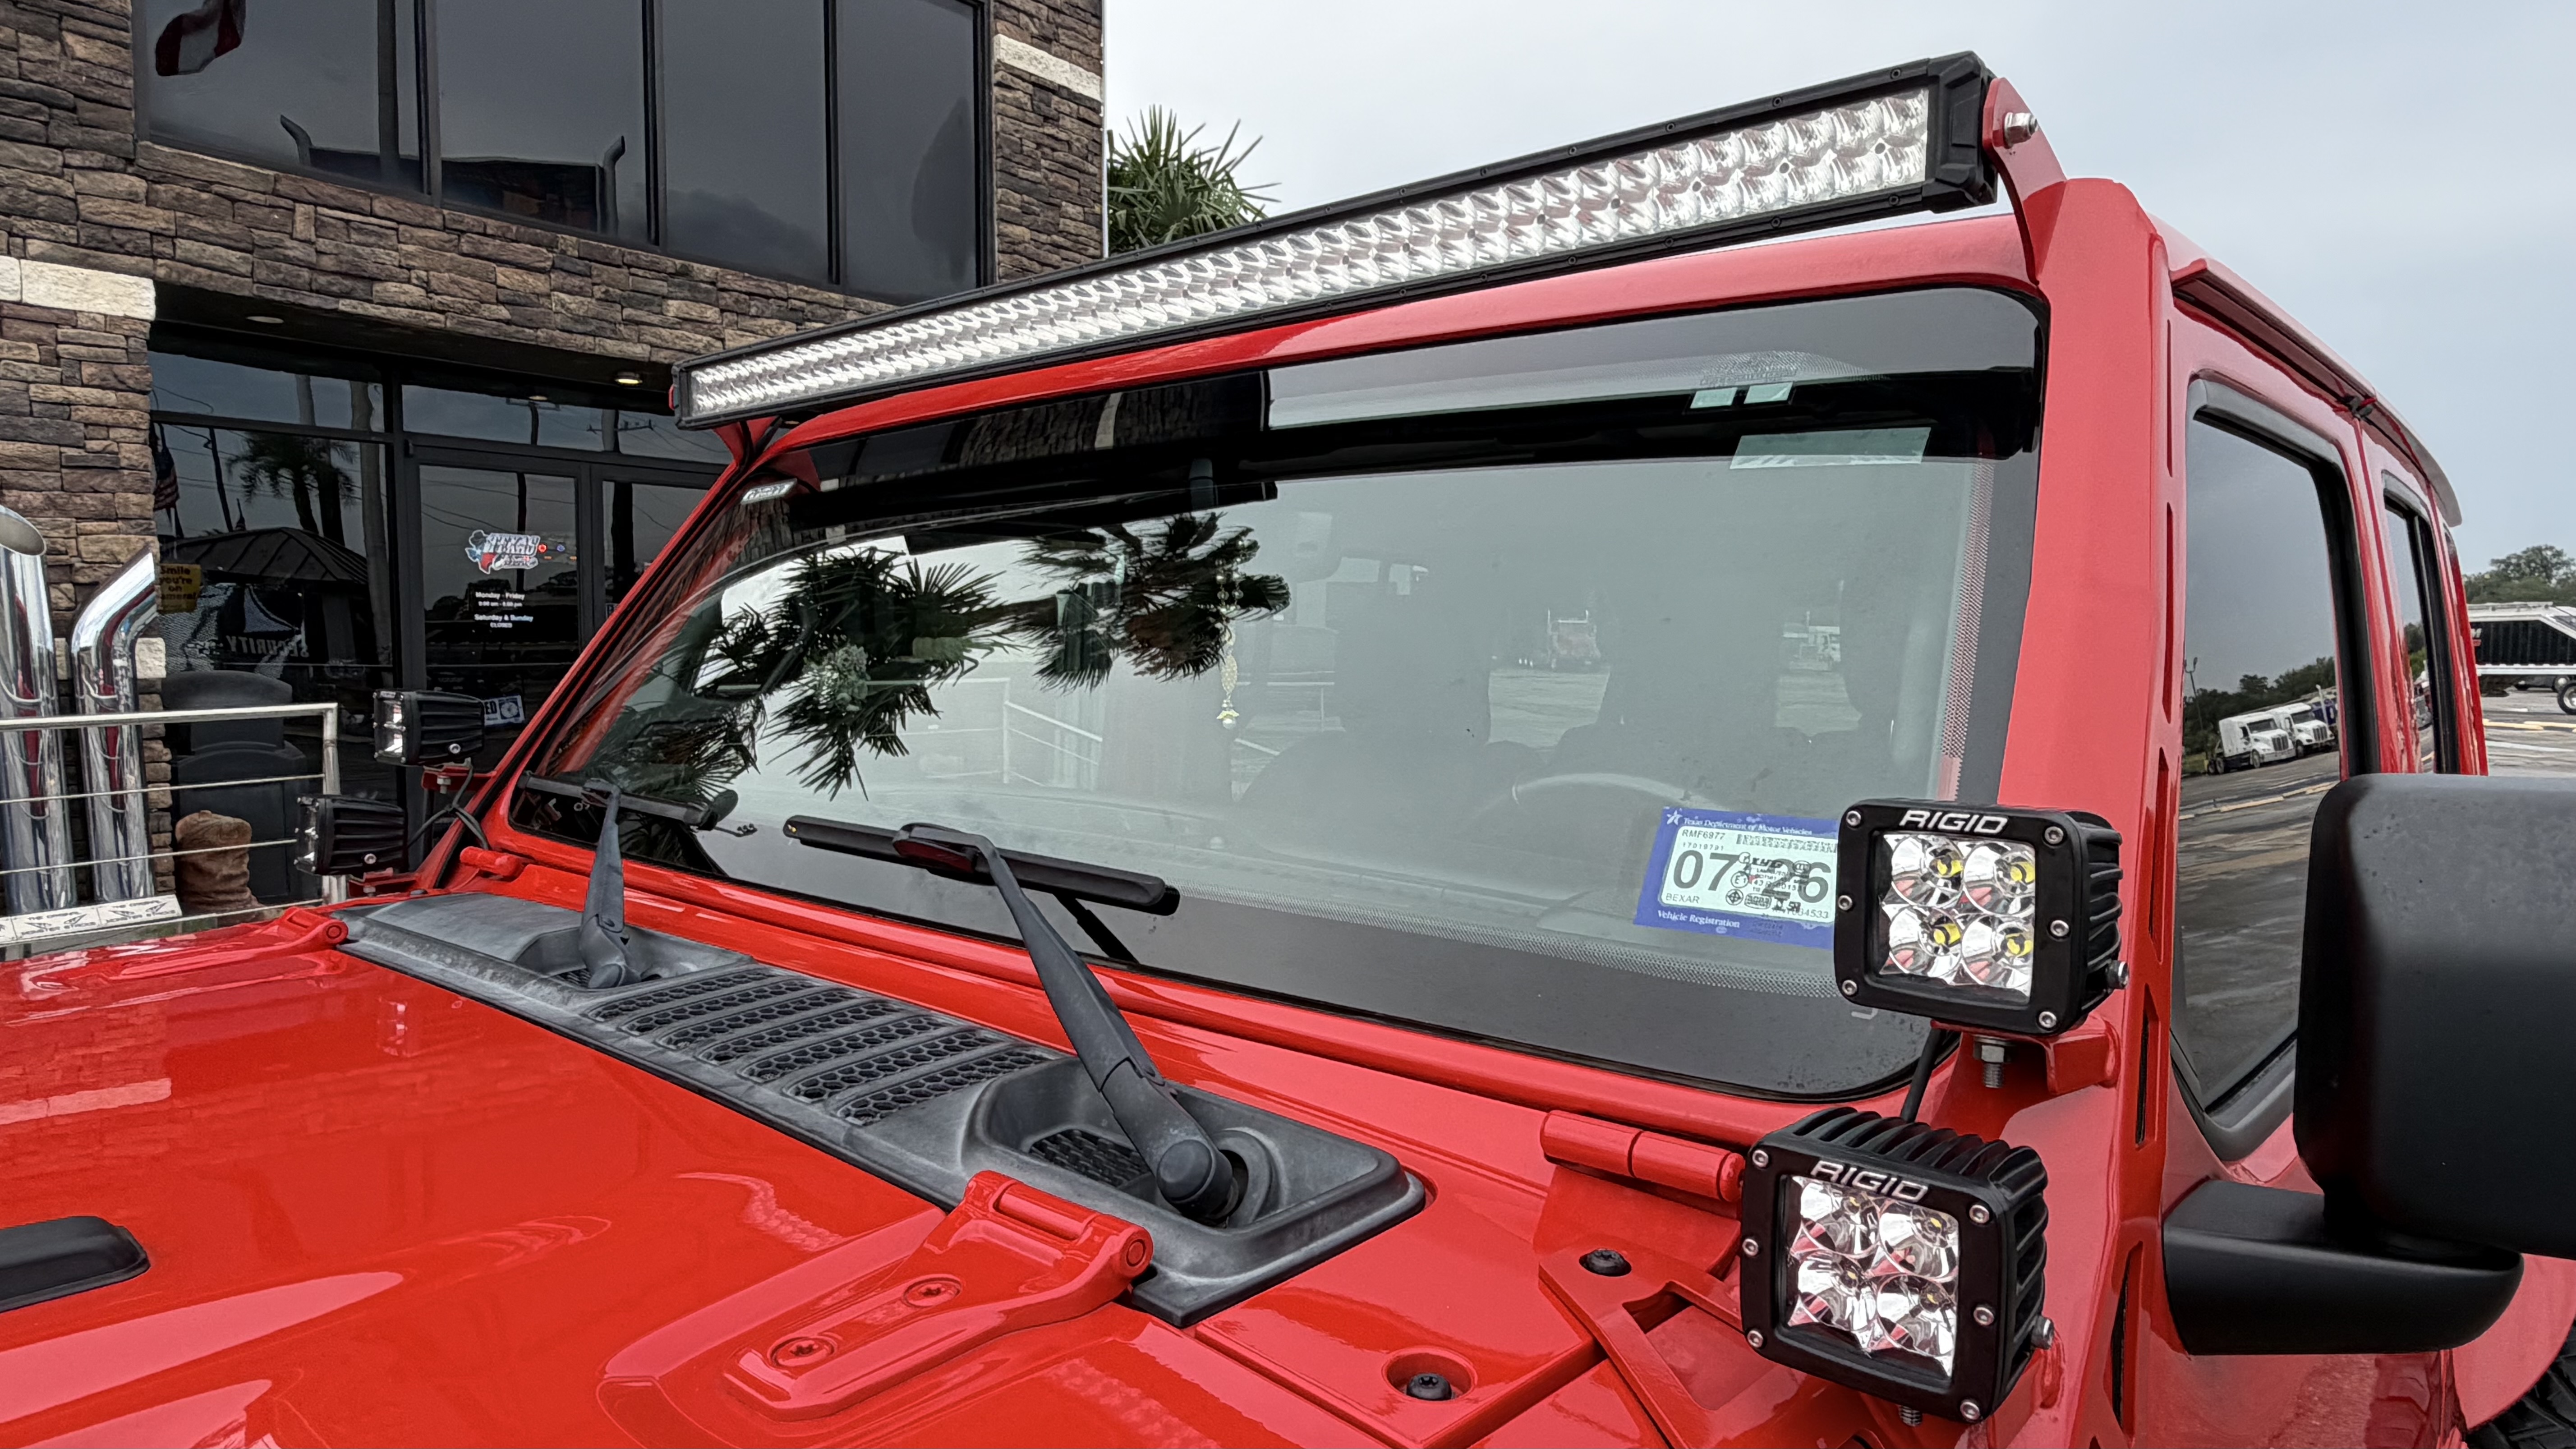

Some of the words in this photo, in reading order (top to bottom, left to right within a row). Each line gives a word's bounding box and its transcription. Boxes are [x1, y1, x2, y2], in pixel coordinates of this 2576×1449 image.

[160, 566, 191, 575] Smile
[475, 591, 501, 600] Monday
[505, 592, 525, 601] Friday
[474, 614, 502, 622] Saturday
[510, 614, 534, 622] Sunday
[1899, 810, 2009, 834] RIGID
[1682, 829, 1725, 840] RMF6977
[1673, 850, 1740, 892] 07
[1761, 858, 1831, 903] 26
[1665, 892, 1700, 904] BEXAR
[1658, 910, 1688, 921] Vehicle
[1689, 914, 1740, 928] Registration
[1810, 1160, 1928, 1202] RIGID
